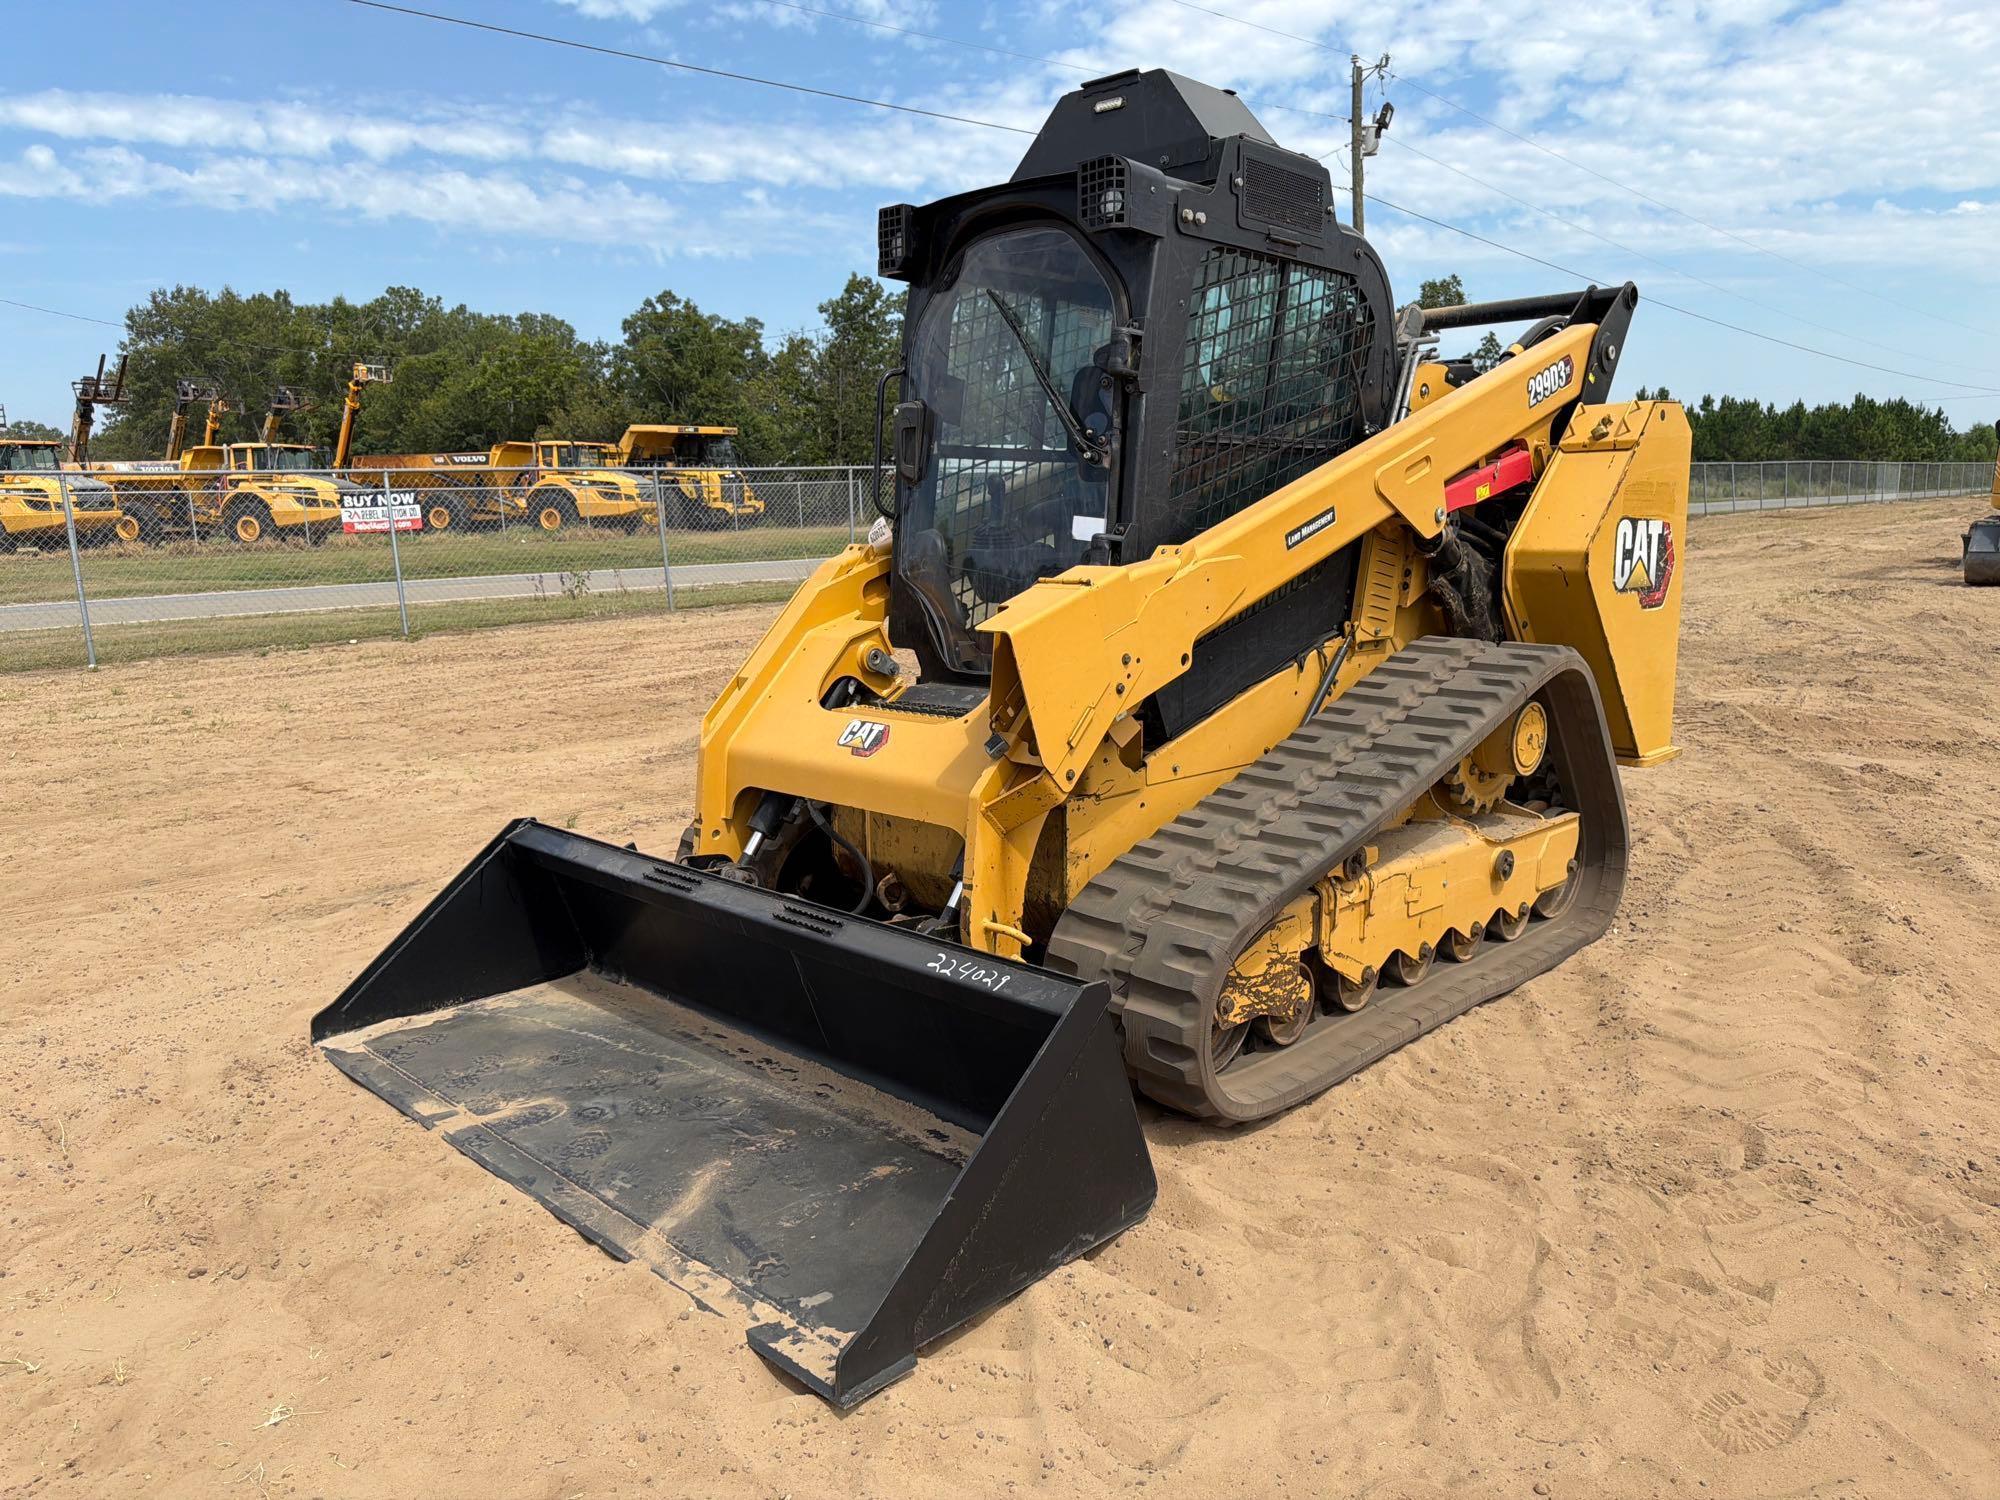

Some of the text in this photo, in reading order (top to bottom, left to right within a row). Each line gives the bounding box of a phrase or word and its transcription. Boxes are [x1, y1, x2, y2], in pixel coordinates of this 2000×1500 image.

[1528, 360, 1566, 407] 299D3
[452, 455, 487, 463] VOLVO
[343, 492, 415, 507] BUY NOW
[381, 507, 407, 519] AUTION
[1615, 518, 1664, 590] CAT
[838, 719, 886, 749] CAT
[926, 952, 1011, 992] 224029
